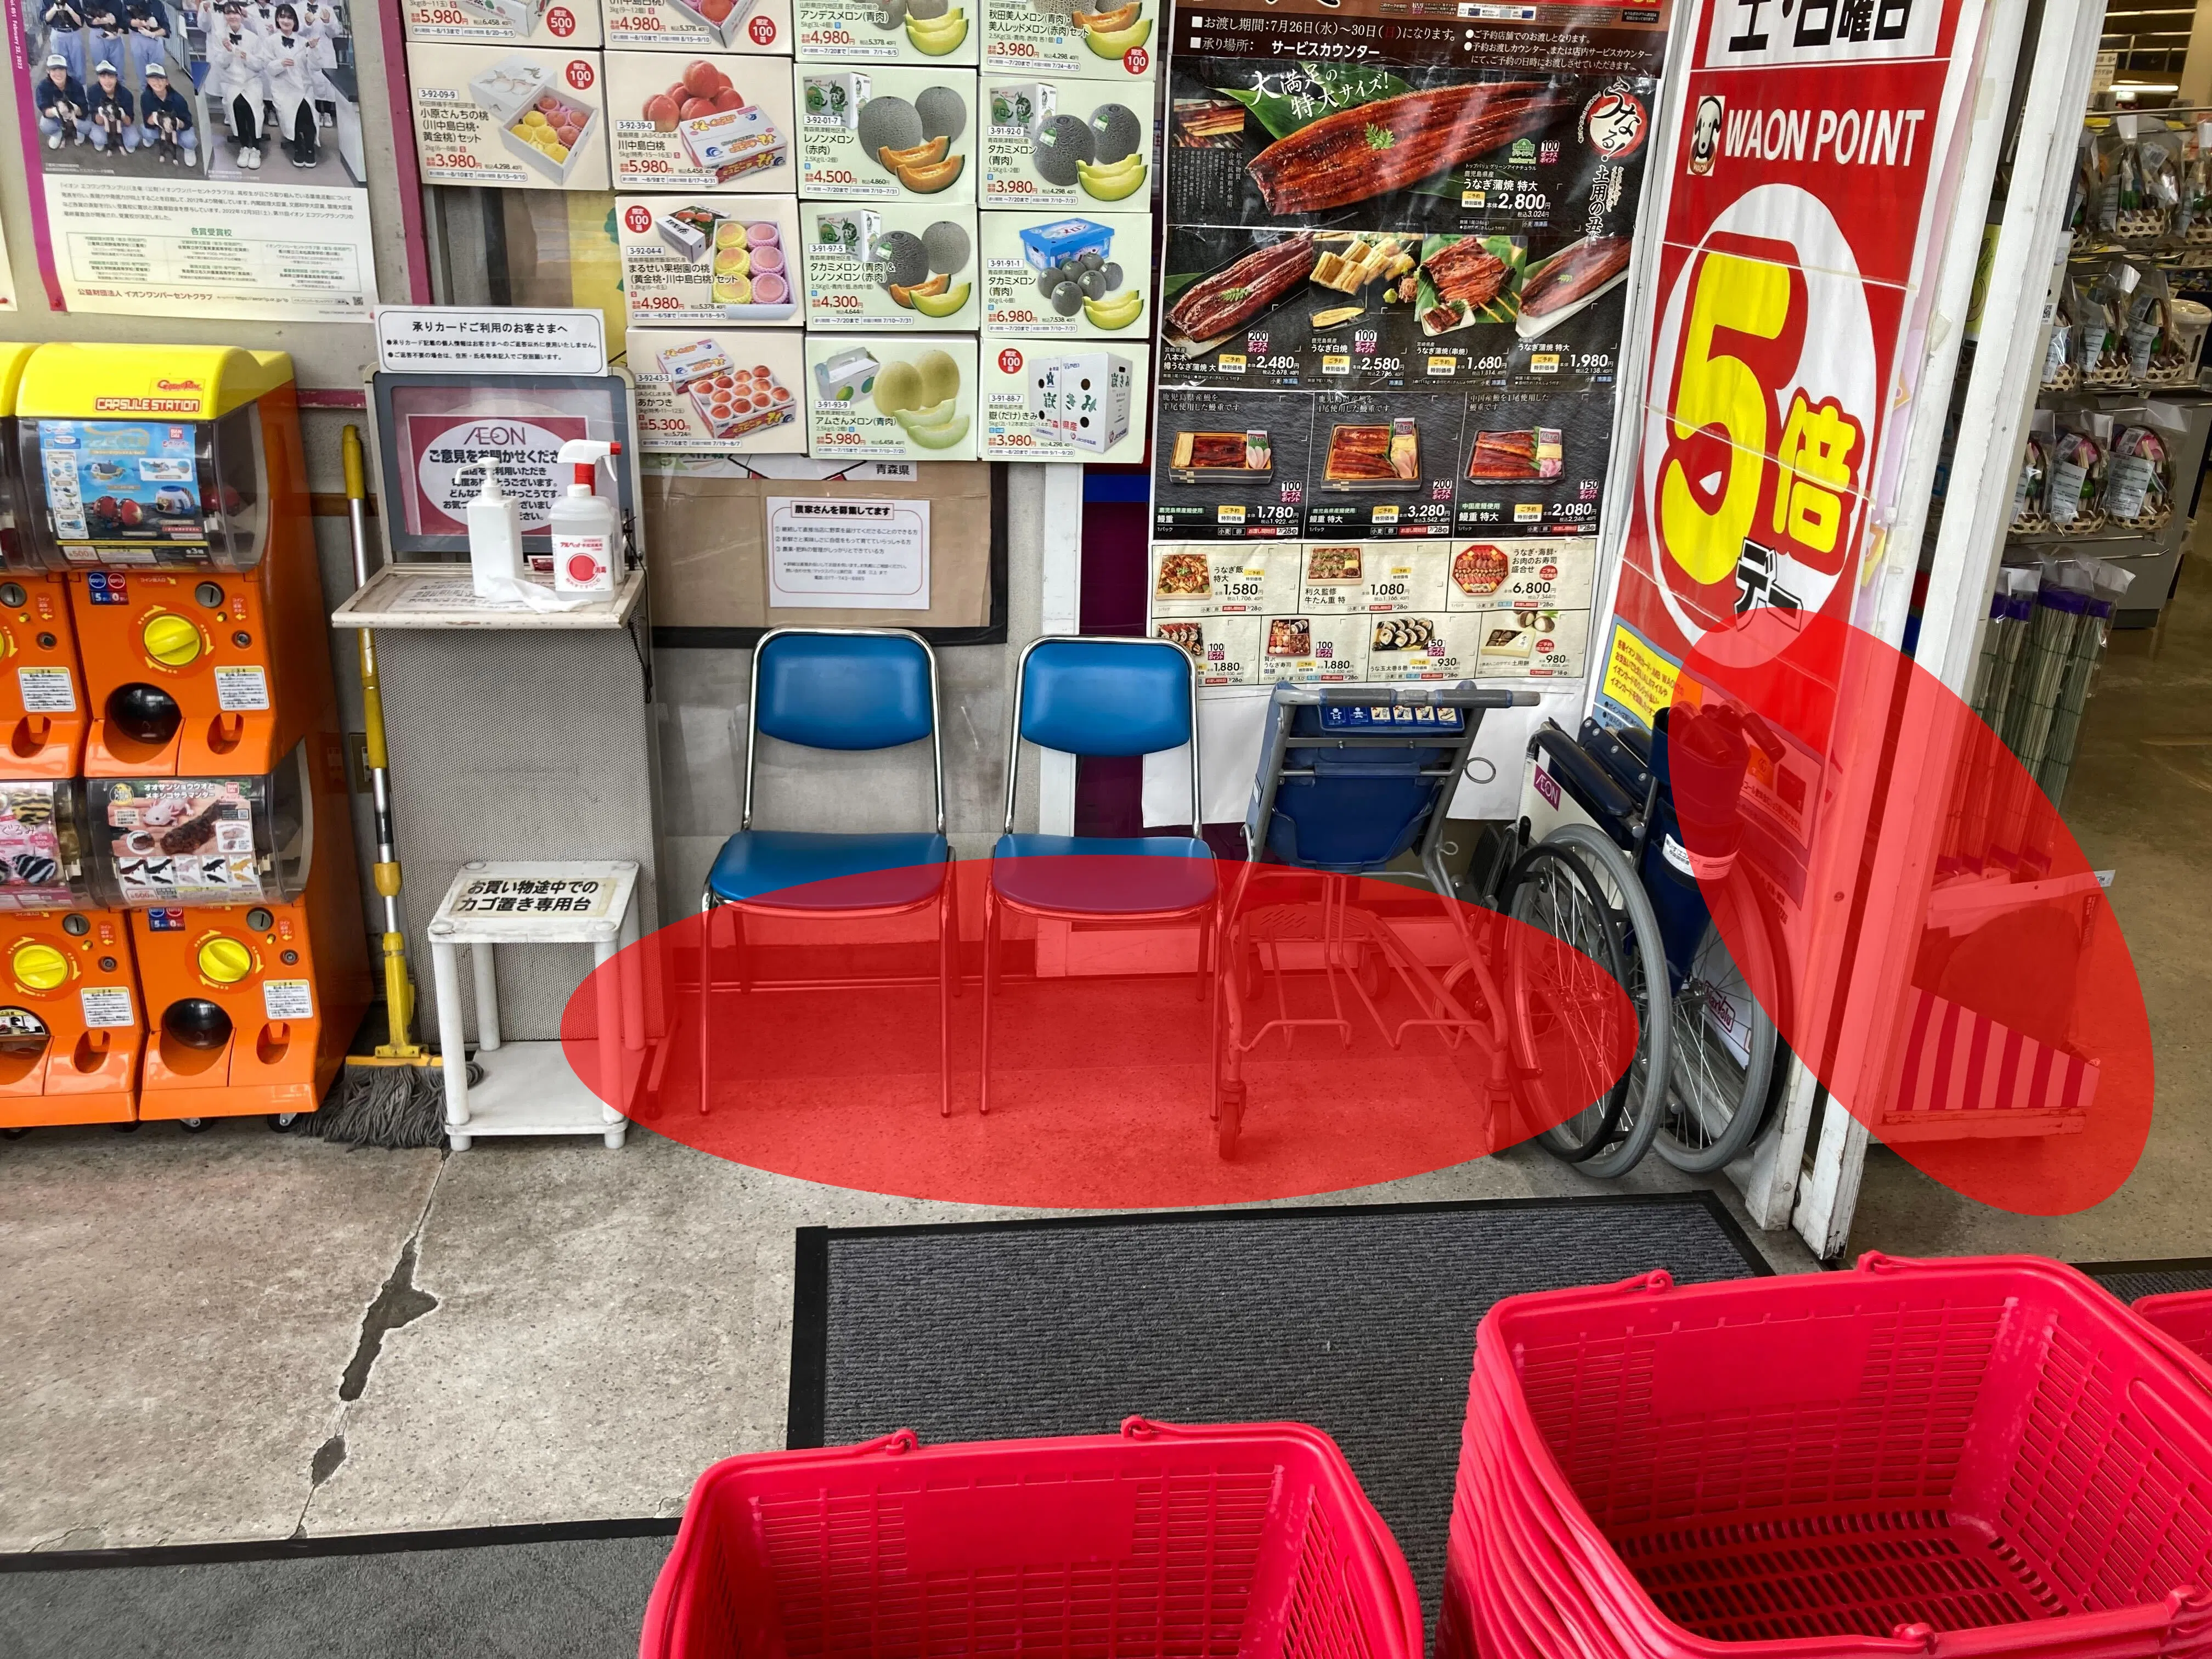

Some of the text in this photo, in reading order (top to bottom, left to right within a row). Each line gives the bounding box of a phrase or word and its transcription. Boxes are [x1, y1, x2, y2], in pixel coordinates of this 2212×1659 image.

[801, 10, 889, 22] アンデスメロン(青肉)
[550, 18, 572, 28] 500
[1474, 30, 1590, 44] ご予約店舗でのお渡しとなります。
[1272, 41, 1380, 57] サービスカウンター
[421, 90, 455, 98] 3-92-09-9
[421, 110, 489, 121] 小原さんちの桃
[804, 135, 854, 144] レノンメロン
[1725, 109, 1925, 166] WAON POINT
[618, 142, 665, 151] 川中島白桃
[806, 145, 830, 155] (赤肉)
[988, 145, 1036, 155] タカミメロン
[1542, 140, 1559, 151] 100
[989, 156, 1013, 166] (青肉)
[1464, 179, 1538, 192] うなぎ蒲焼 特大
[190, 227, 233, 238] 各賞受賞校
[629, 264, 710, 273] まるせい果樹園の桃
[811, 273, 887, 282] レノンメロン(赤肉)
[988, 277, 1036, 285] タカミメロン
[412, 321, 568, 334] 承りカードご利用のお客さまへ
[1312, 344, 1347, 353] うなぎ白焼
[1518, 343, 1570, 352] うなぎ蒲焼 特大
[1164, 353, 1187, 362] 八本木
[1209, 363, 1216, 372] 大
[96, 398, 200, 411] CAPSULE STATION
[638, 399, 673, 407] あかつき
[816, 417, 896, 426] アムさんメロン(青肉)
[430, 449, 558, 464] ご意見をお聞かせくださ
[876, 464, 910, 475] 青森県
[795, 505, 890, 516] 農家さんを募集してます
[1157, 515, 1173, 523] 鰻重
[1309, 515, 1325, 523] 鰻重
[1459, 512, 1498, 521] 鰻重 特大
[1305, 588, 1336, 596] 利久監修
[1305, 596, 1335, 604] 牛たん重
[467, 880, 599, 894] お買い物途中での
[458, 896, 591, 912] カゴ置き専用台
